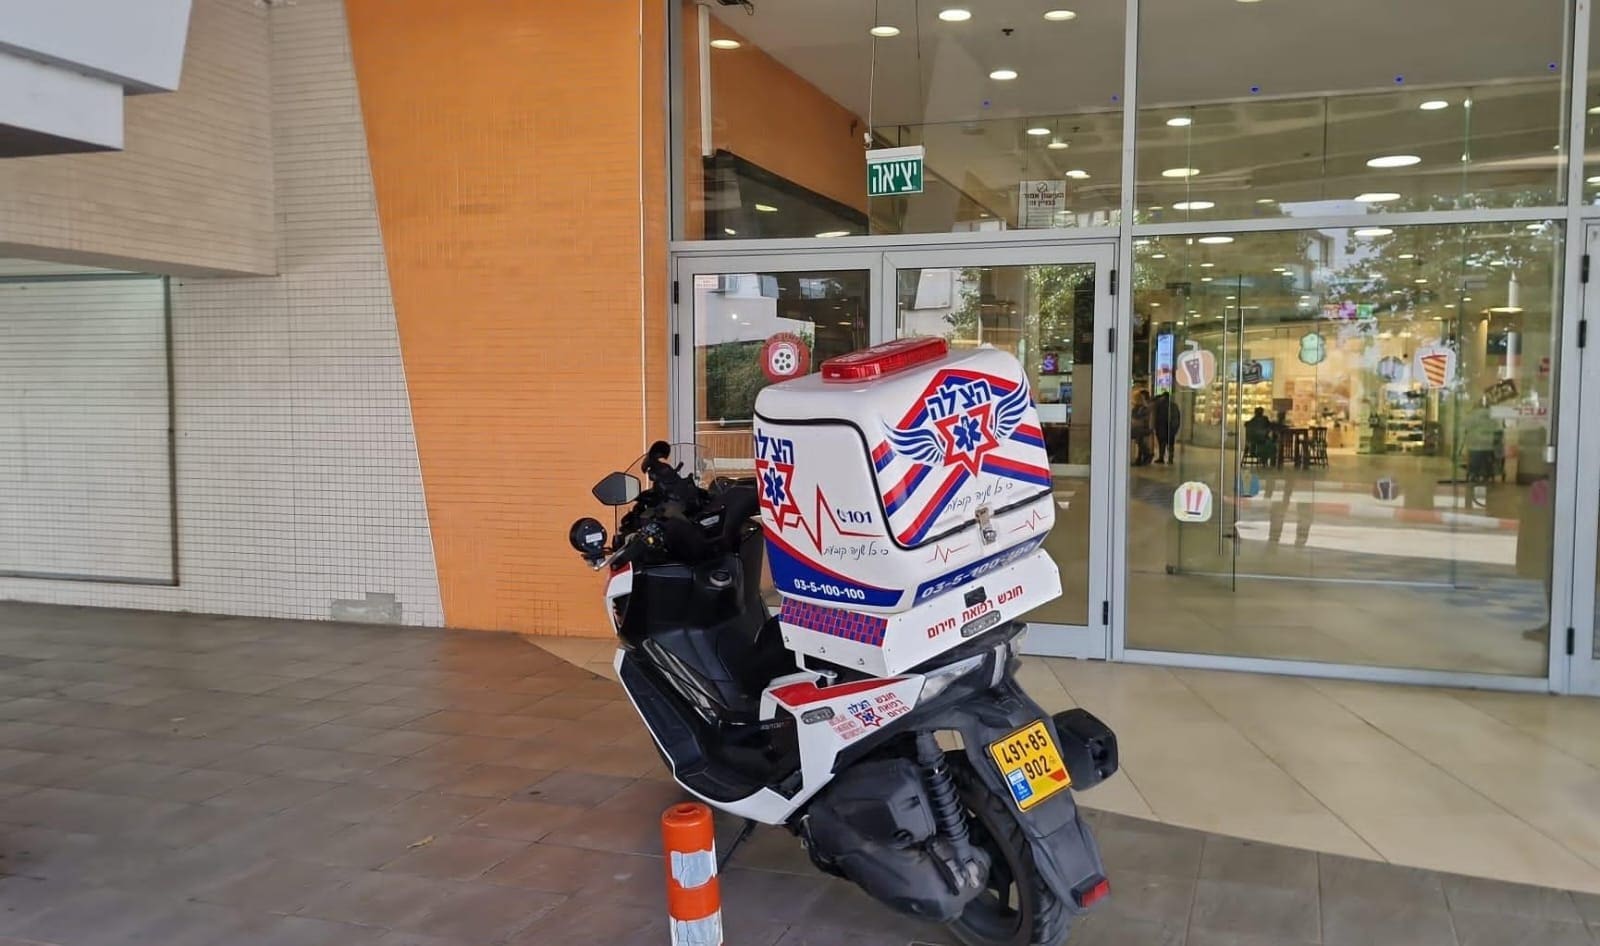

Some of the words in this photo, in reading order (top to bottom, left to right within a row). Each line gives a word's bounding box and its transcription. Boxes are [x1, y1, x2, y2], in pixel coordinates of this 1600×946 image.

[872, 161, 918, 193] יציאה
[927, 381, 991, 420] הצלה
[994, 477, 1003, 495] כל
[847, 511, 873, 524] 101
[868, 541, 877, 556] כל
[880, 548, 889, 556] כי
[794, 577, 866, 600] 03-5-100-100
[997, 585, 1024, 605] חובש
[962, 600, 994, 623] רפואת
[926, 617, 957, 639] חירום
[847, 699, 872, 715] הצלה
[874, 692, 897, 704] חובש
[1024, 755, 1051, 780] 902
